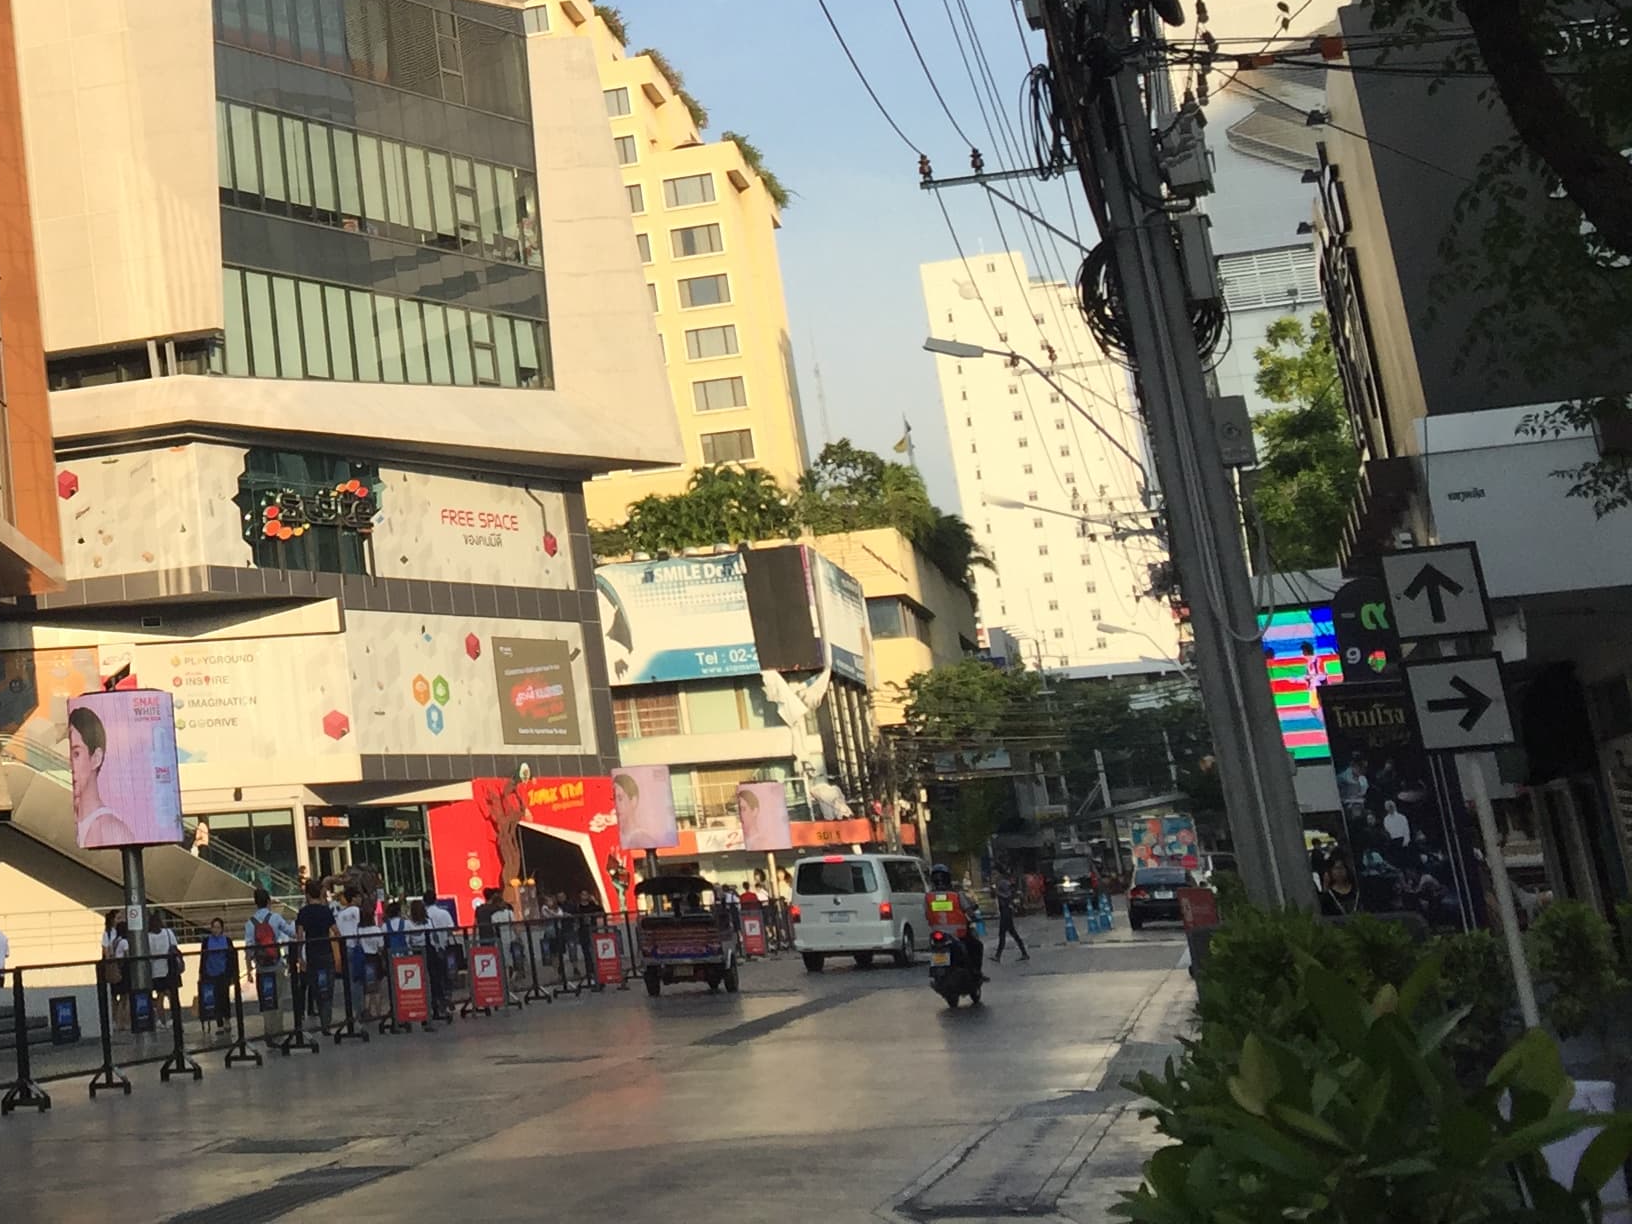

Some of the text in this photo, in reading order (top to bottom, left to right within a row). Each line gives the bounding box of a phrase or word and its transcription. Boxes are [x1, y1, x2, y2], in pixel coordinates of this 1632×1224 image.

[440, 508, 520, 531] FREE SPACE
[653, 565, 701, 583] SMILE
[695, 651, 719, 665] Tel
[133, 696, 161, 707] SNAIL
[133, 706, 161, 716] WHITE
[1331, 702, 1405, 729] โหมโรง
